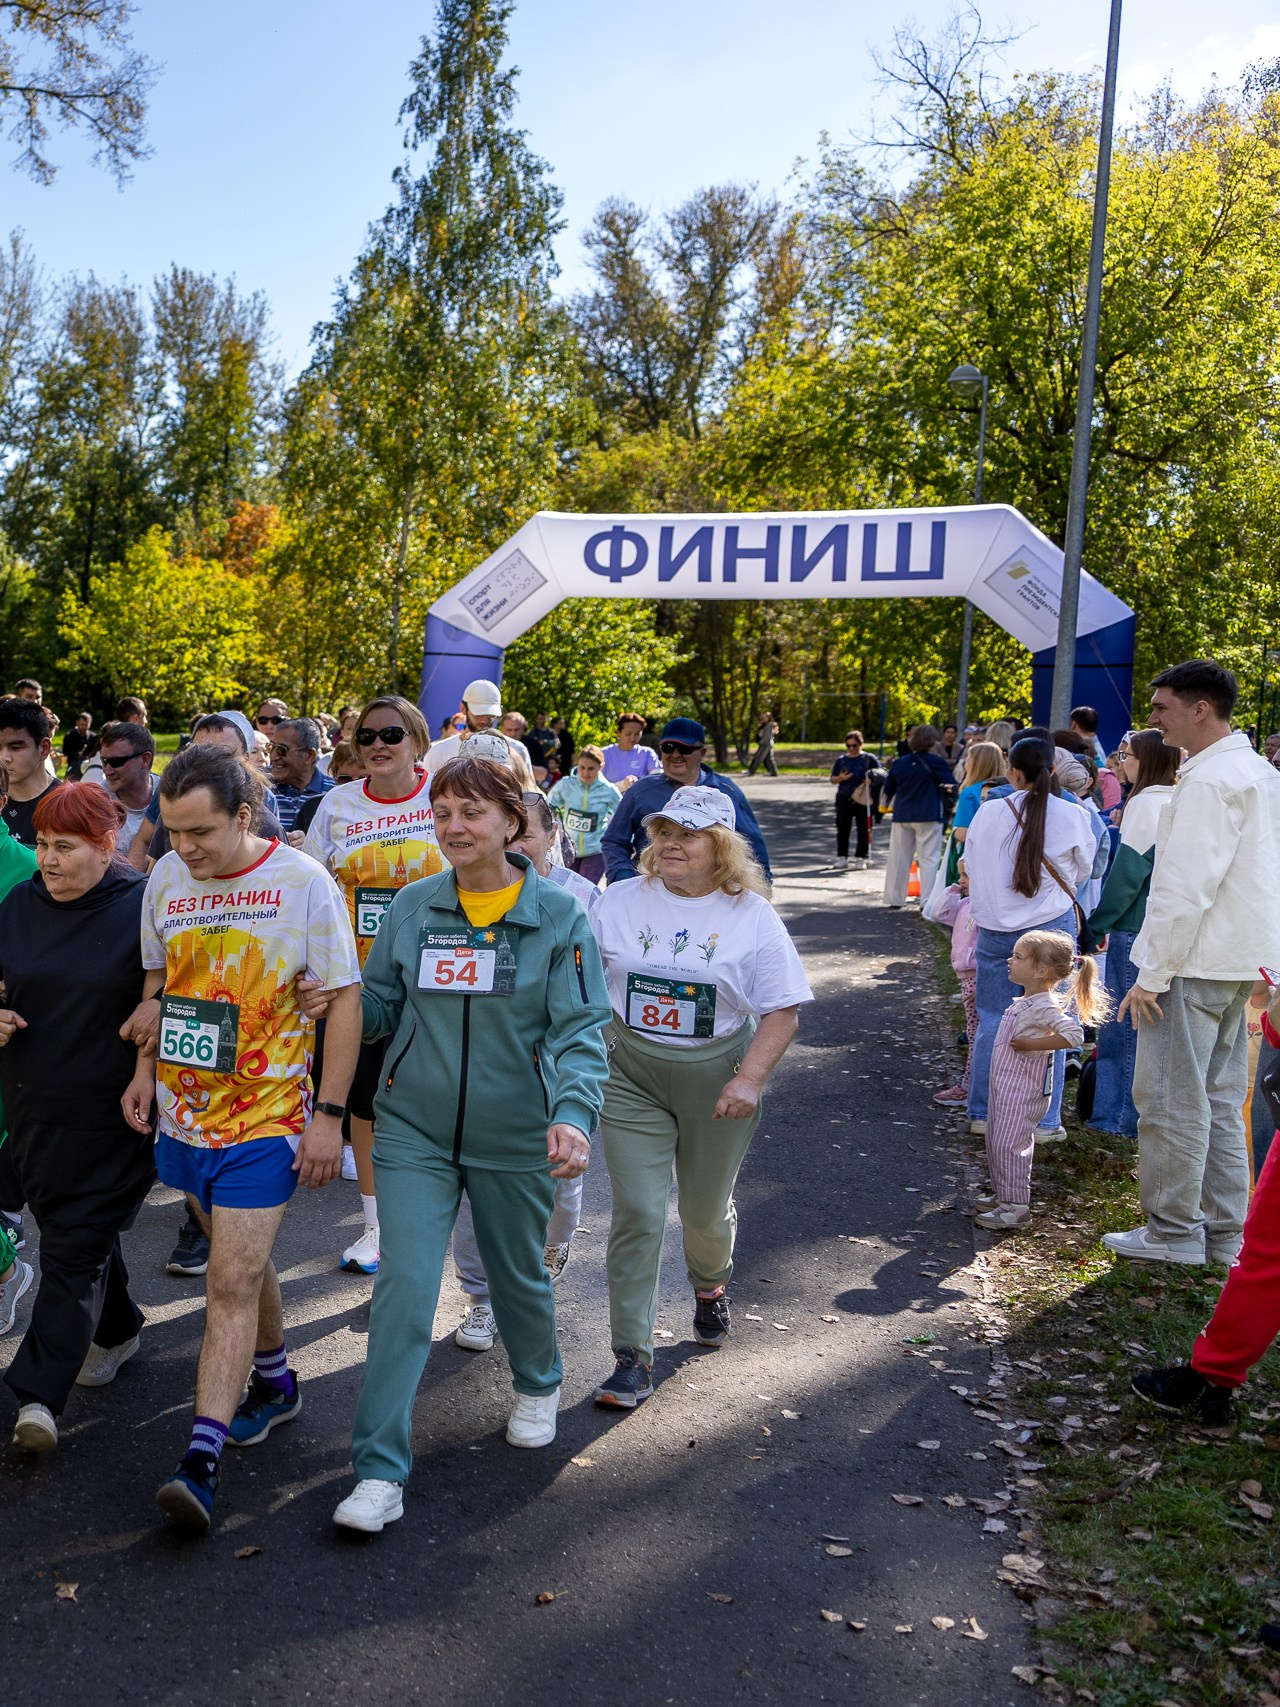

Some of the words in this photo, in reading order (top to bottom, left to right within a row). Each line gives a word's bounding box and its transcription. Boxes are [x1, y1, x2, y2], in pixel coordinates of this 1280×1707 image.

[583, 521, 947, 583] ФИНИШ
[468, 584, 492, 606] спорт
[475, 598, 491, 615] для
[482, 597, 509, 621] жизни
[346, 820, 373, 838] БЕЗ
[377, 808, 434, 829] ГРАНИ
[569, 819, 589, 830] 626
[345, 823, 435, 848] БЛАГОТВОРИТЕЛЬНЫ
[380, 837, 408, 848] ЗАБЕГ
[167, 897, 197, 915] БЕЗ
[200, 889, 281, 910] ГРАНИЦ
[164, 908, 278, 929] БЛАГОТВОРИТЕЛЬНЫЙ
[201, 925, 232, 936] ЗАБЕГ
[434, 960, 478, 986] 54
[641, 1004, 682, 1031] 84
[163, 1029, 214, 1062] 566
